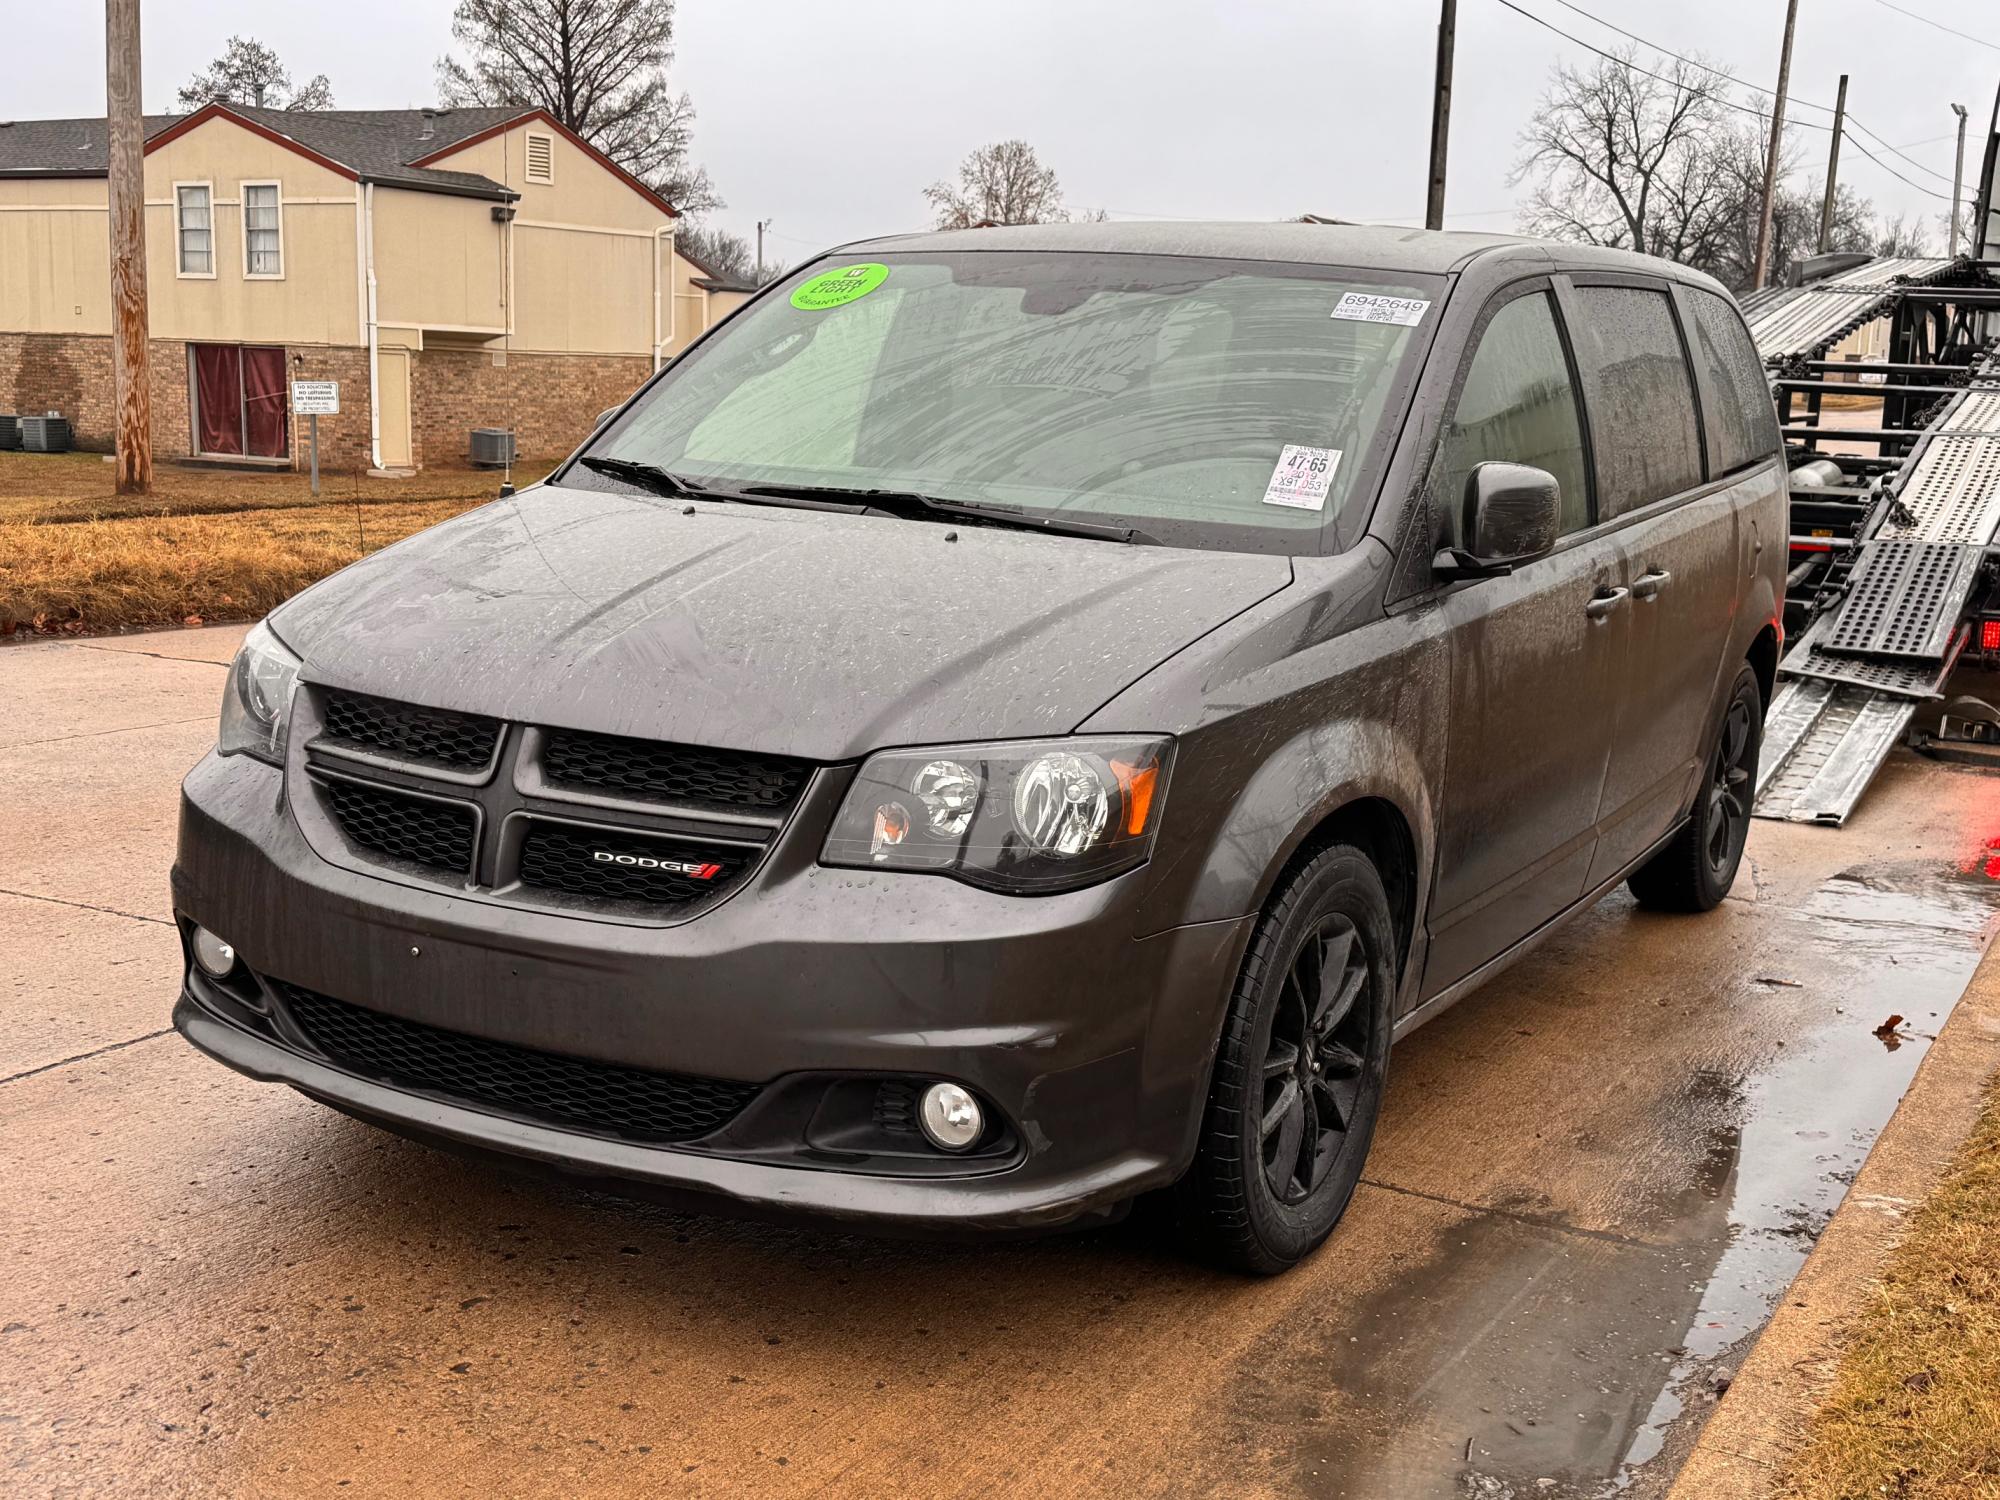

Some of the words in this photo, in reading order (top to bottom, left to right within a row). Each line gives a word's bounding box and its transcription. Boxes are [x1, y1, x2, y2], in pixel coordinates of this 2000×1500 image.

[809, 286, 857, 294] LIGHT
[819, 279, 868, 288] GREEN
[1344, 295, 1424, 312] 6942649
[594, 851, 702, 875] DODGE
